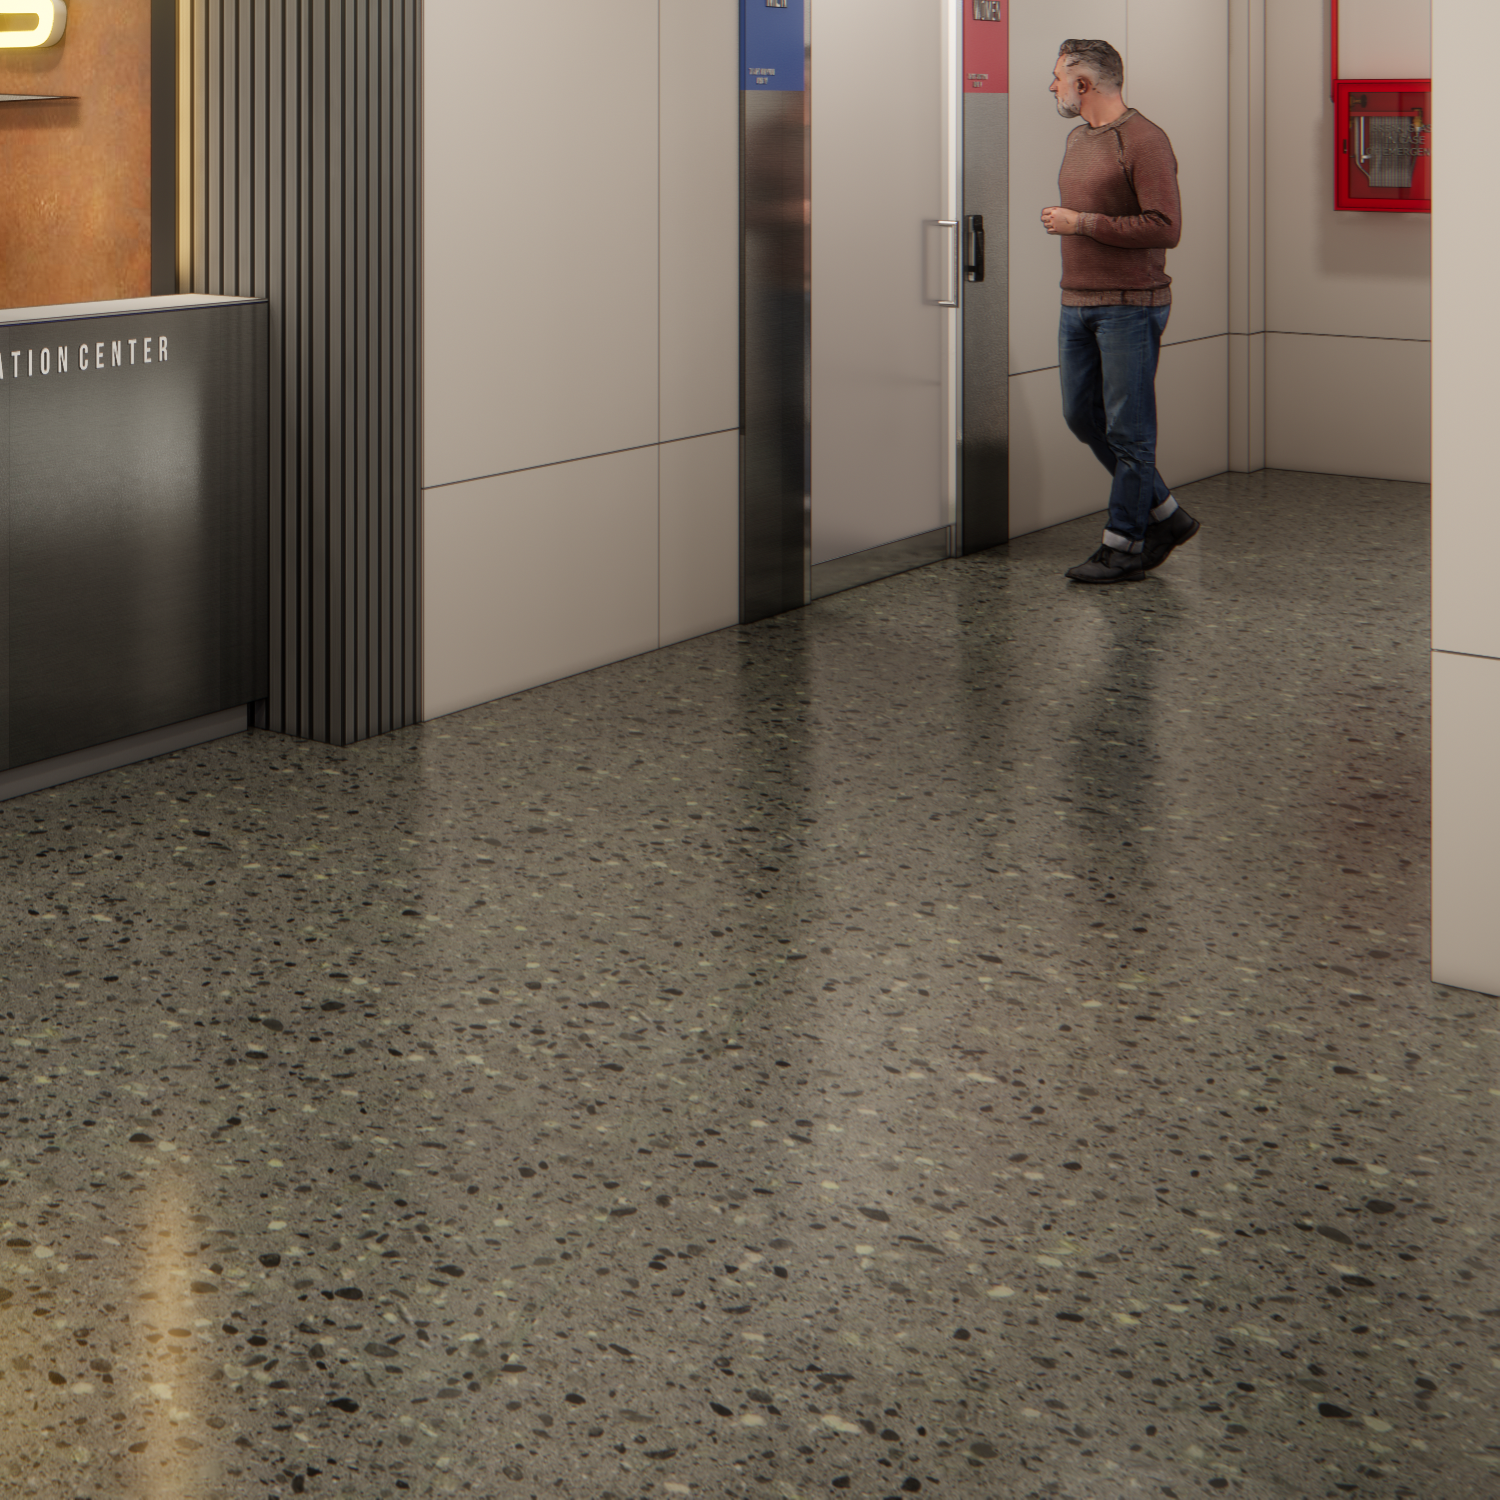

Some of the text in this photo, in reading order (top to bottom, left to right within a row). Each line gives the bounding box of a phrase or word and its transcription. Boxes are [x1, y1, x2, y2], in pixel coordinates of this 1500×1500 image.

[972, 0, 1001, 22] WOMEN
[1382, 147, 1431, 157] EMERGEN
[79, 335, 168, 372] CENTER
